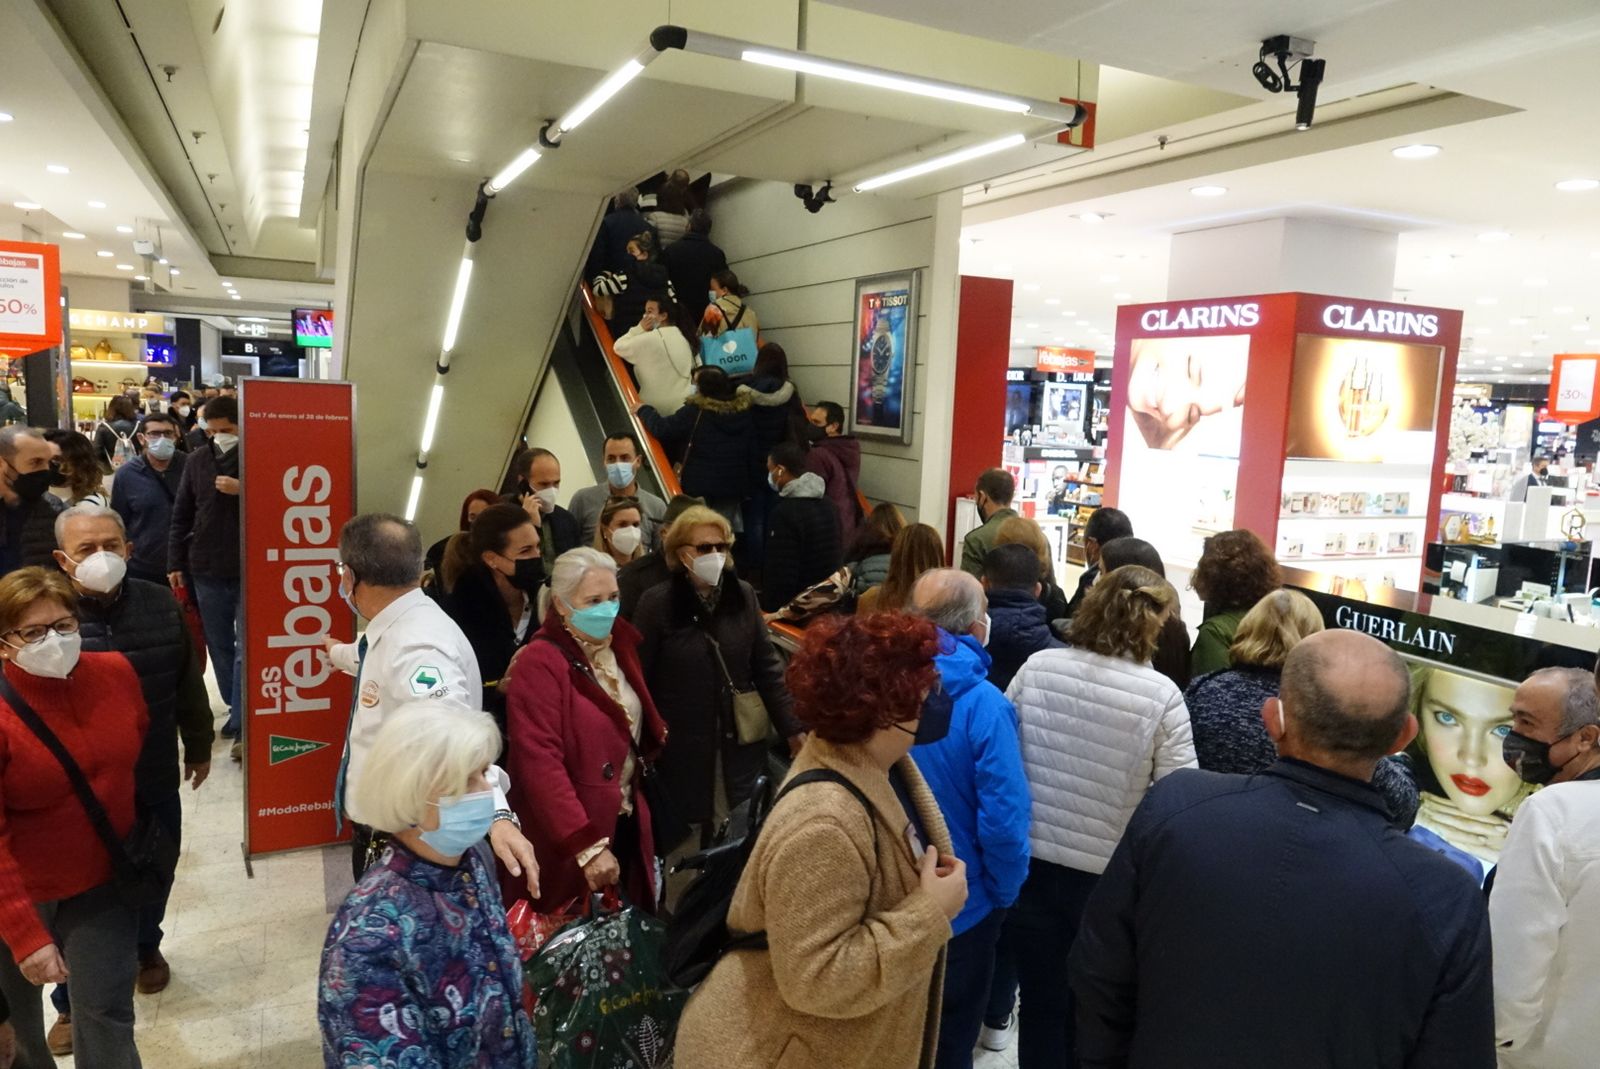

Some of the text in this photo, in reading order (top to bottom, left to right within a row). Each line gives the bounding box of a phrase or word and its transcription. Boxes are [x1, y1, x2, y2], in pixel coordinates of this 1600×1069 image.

[882, 295, 907, 307] TISSOT
[1141, 303, 1260, 331] CLARINS
[1323, 304, 1438, 337] CLARINS
[720, 354, 747, 365] noon
[1039, 350, 1078, 368] rebajas
[267, 464, 340, 713] rebajas
[255, 666, 282, 715] Las
